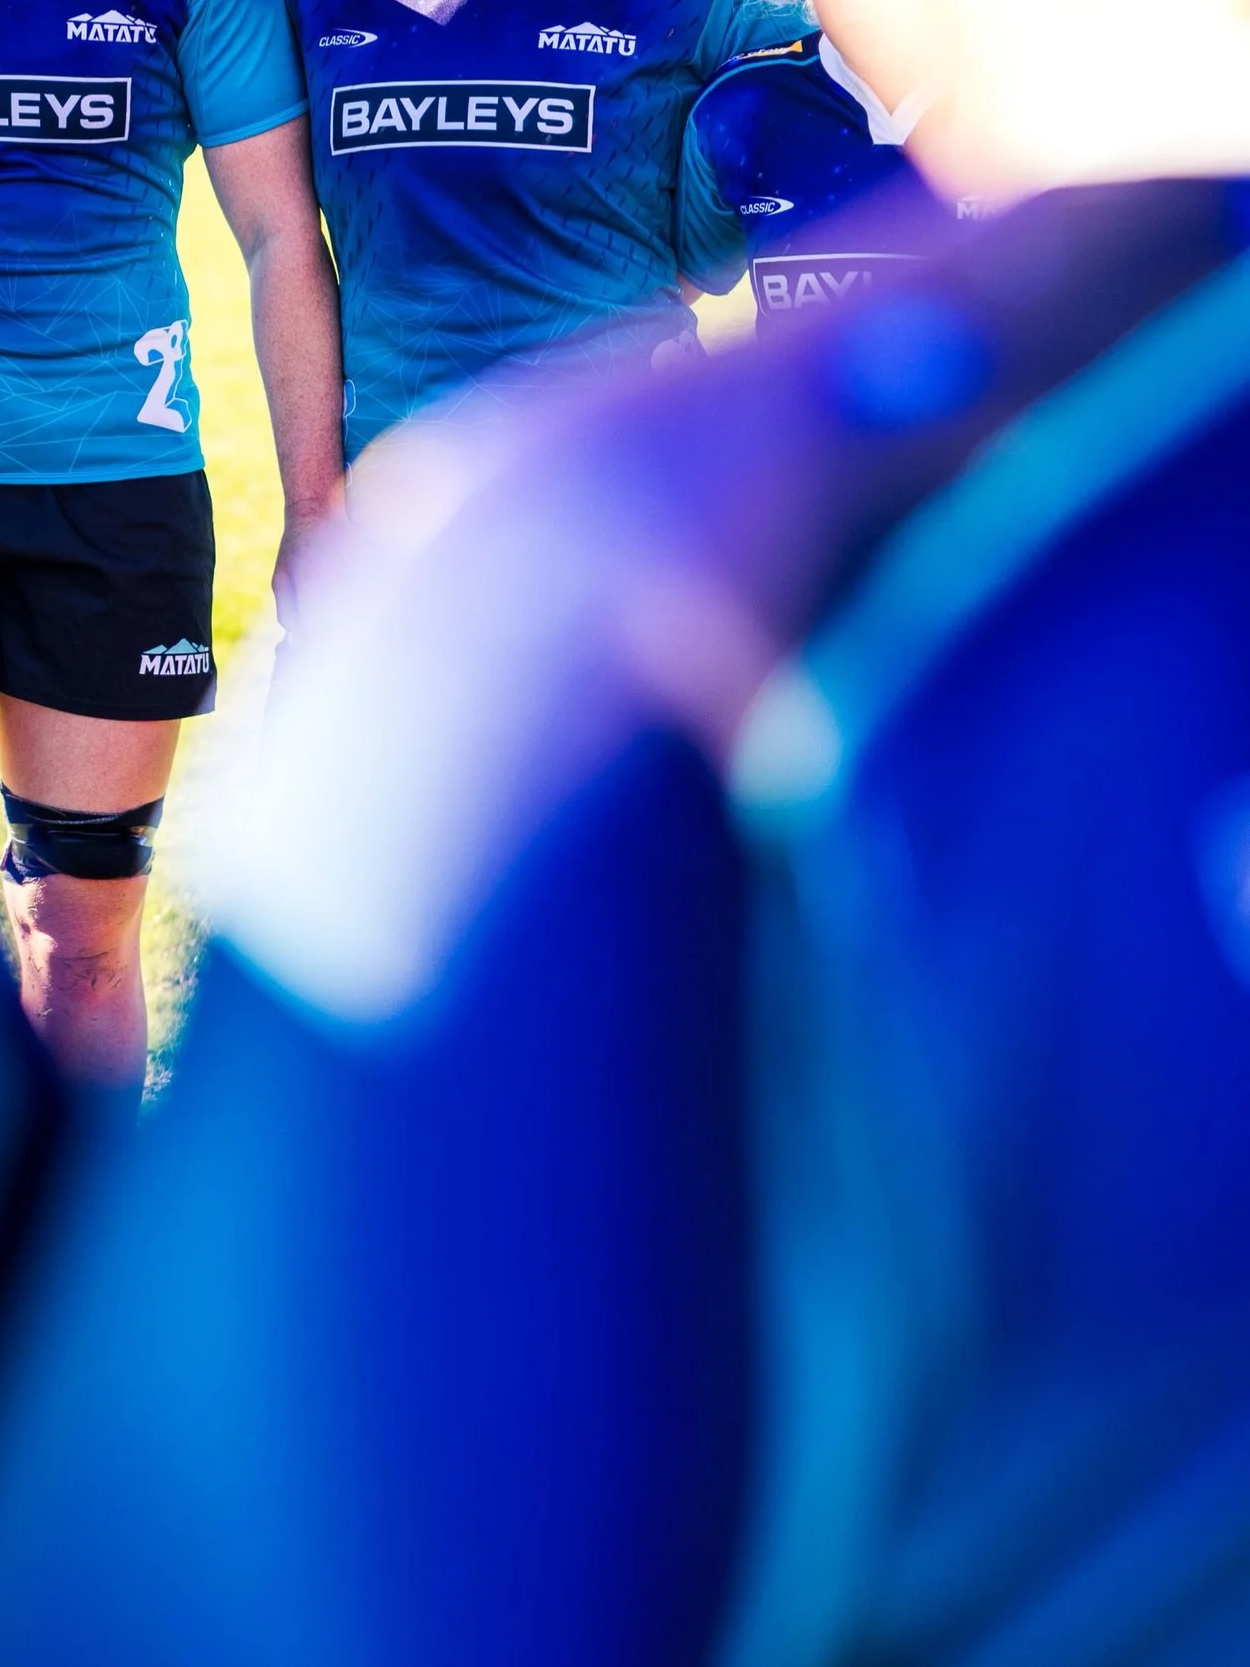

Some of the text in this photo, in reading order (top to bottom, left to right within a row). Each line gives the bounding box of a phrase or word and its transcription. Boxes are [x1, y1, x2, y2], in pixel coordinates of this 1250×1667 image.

[319, 35, 361, 47] CLASSIC
[342, 96, 574, 138] BAYLEYS
[740, 201, 776, 215] CLASSIC
[134, 319, 192, 433] 2
